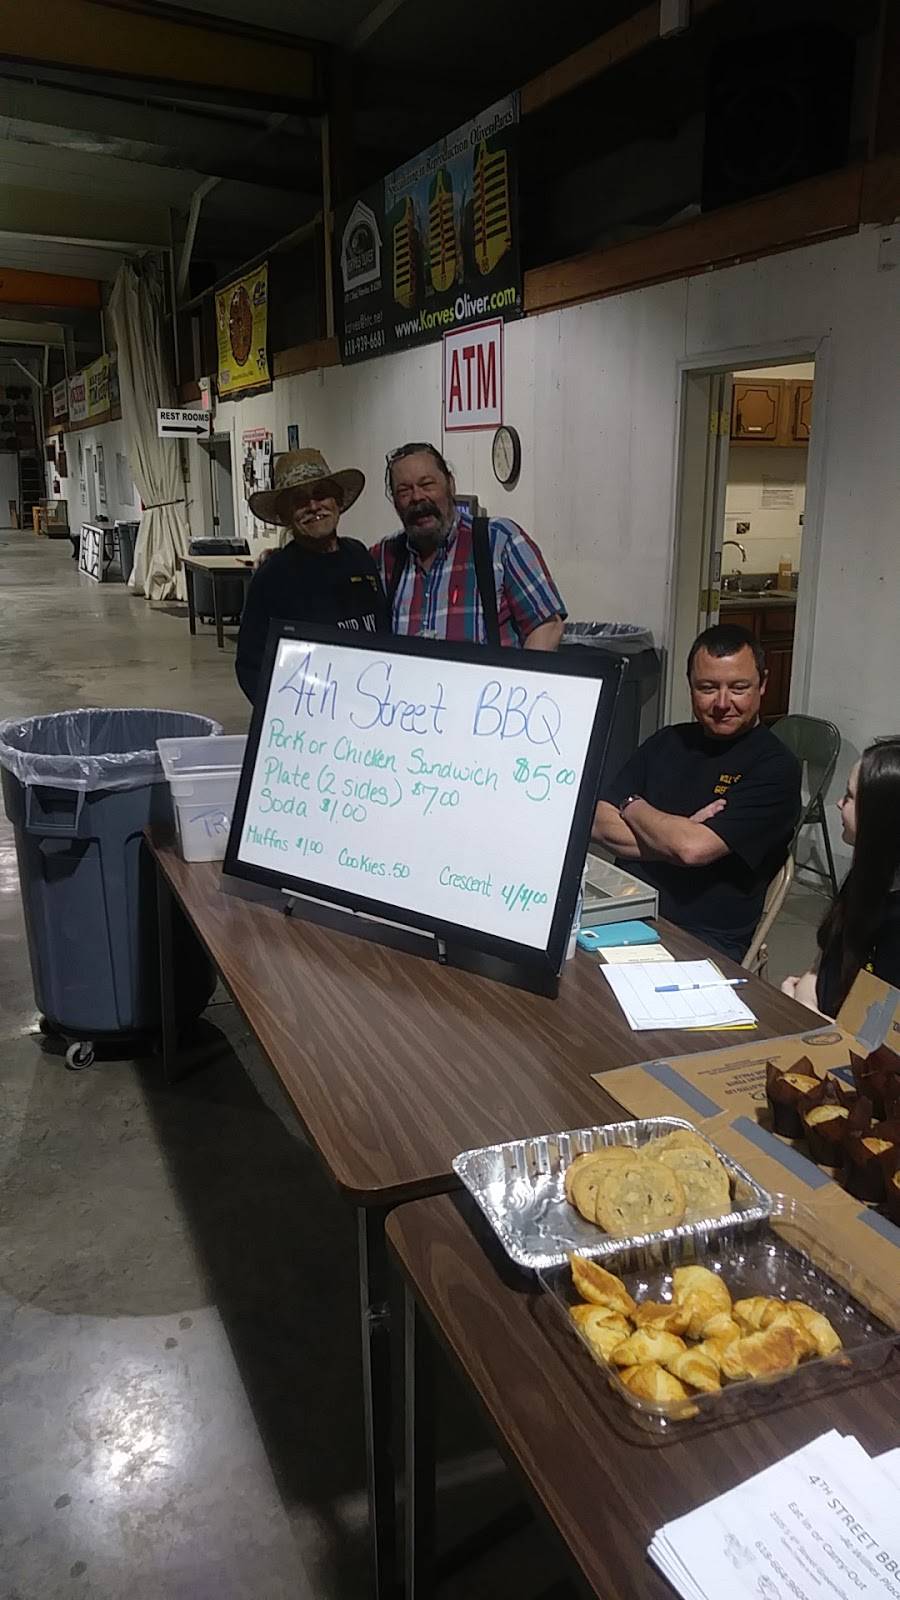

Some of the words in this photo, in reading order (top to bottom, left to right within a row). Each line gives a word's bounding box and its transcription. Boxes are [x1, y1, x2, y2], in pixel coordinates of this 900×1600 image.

[395, 286, 517, 338] www.KorvesOliver.com
[449, 341, 497, 413] ATM
[160, 411, 180, 421] REST
[182, 412, 209, 422] ROOMS
[278, 652, 338, 720] 4th
[350, 660, 447, 735] Street
[473, 680, 562, 756] BBQ
[268, 718, 306, 753] Pork
[308, 740, 328, 755] or
[333, 736, 397, 773] Chicken
[407, 748, 499, 791] Sandwich
[259, 787, 308, 818] Soda
[264, 756, 311, 791] Plate
[317, 764, 336, 795] (2
[342, 778, 403, 808] sides)
[439, 865, 493, 897] Crescent
[826, 1497, 880, 1550] STREET
